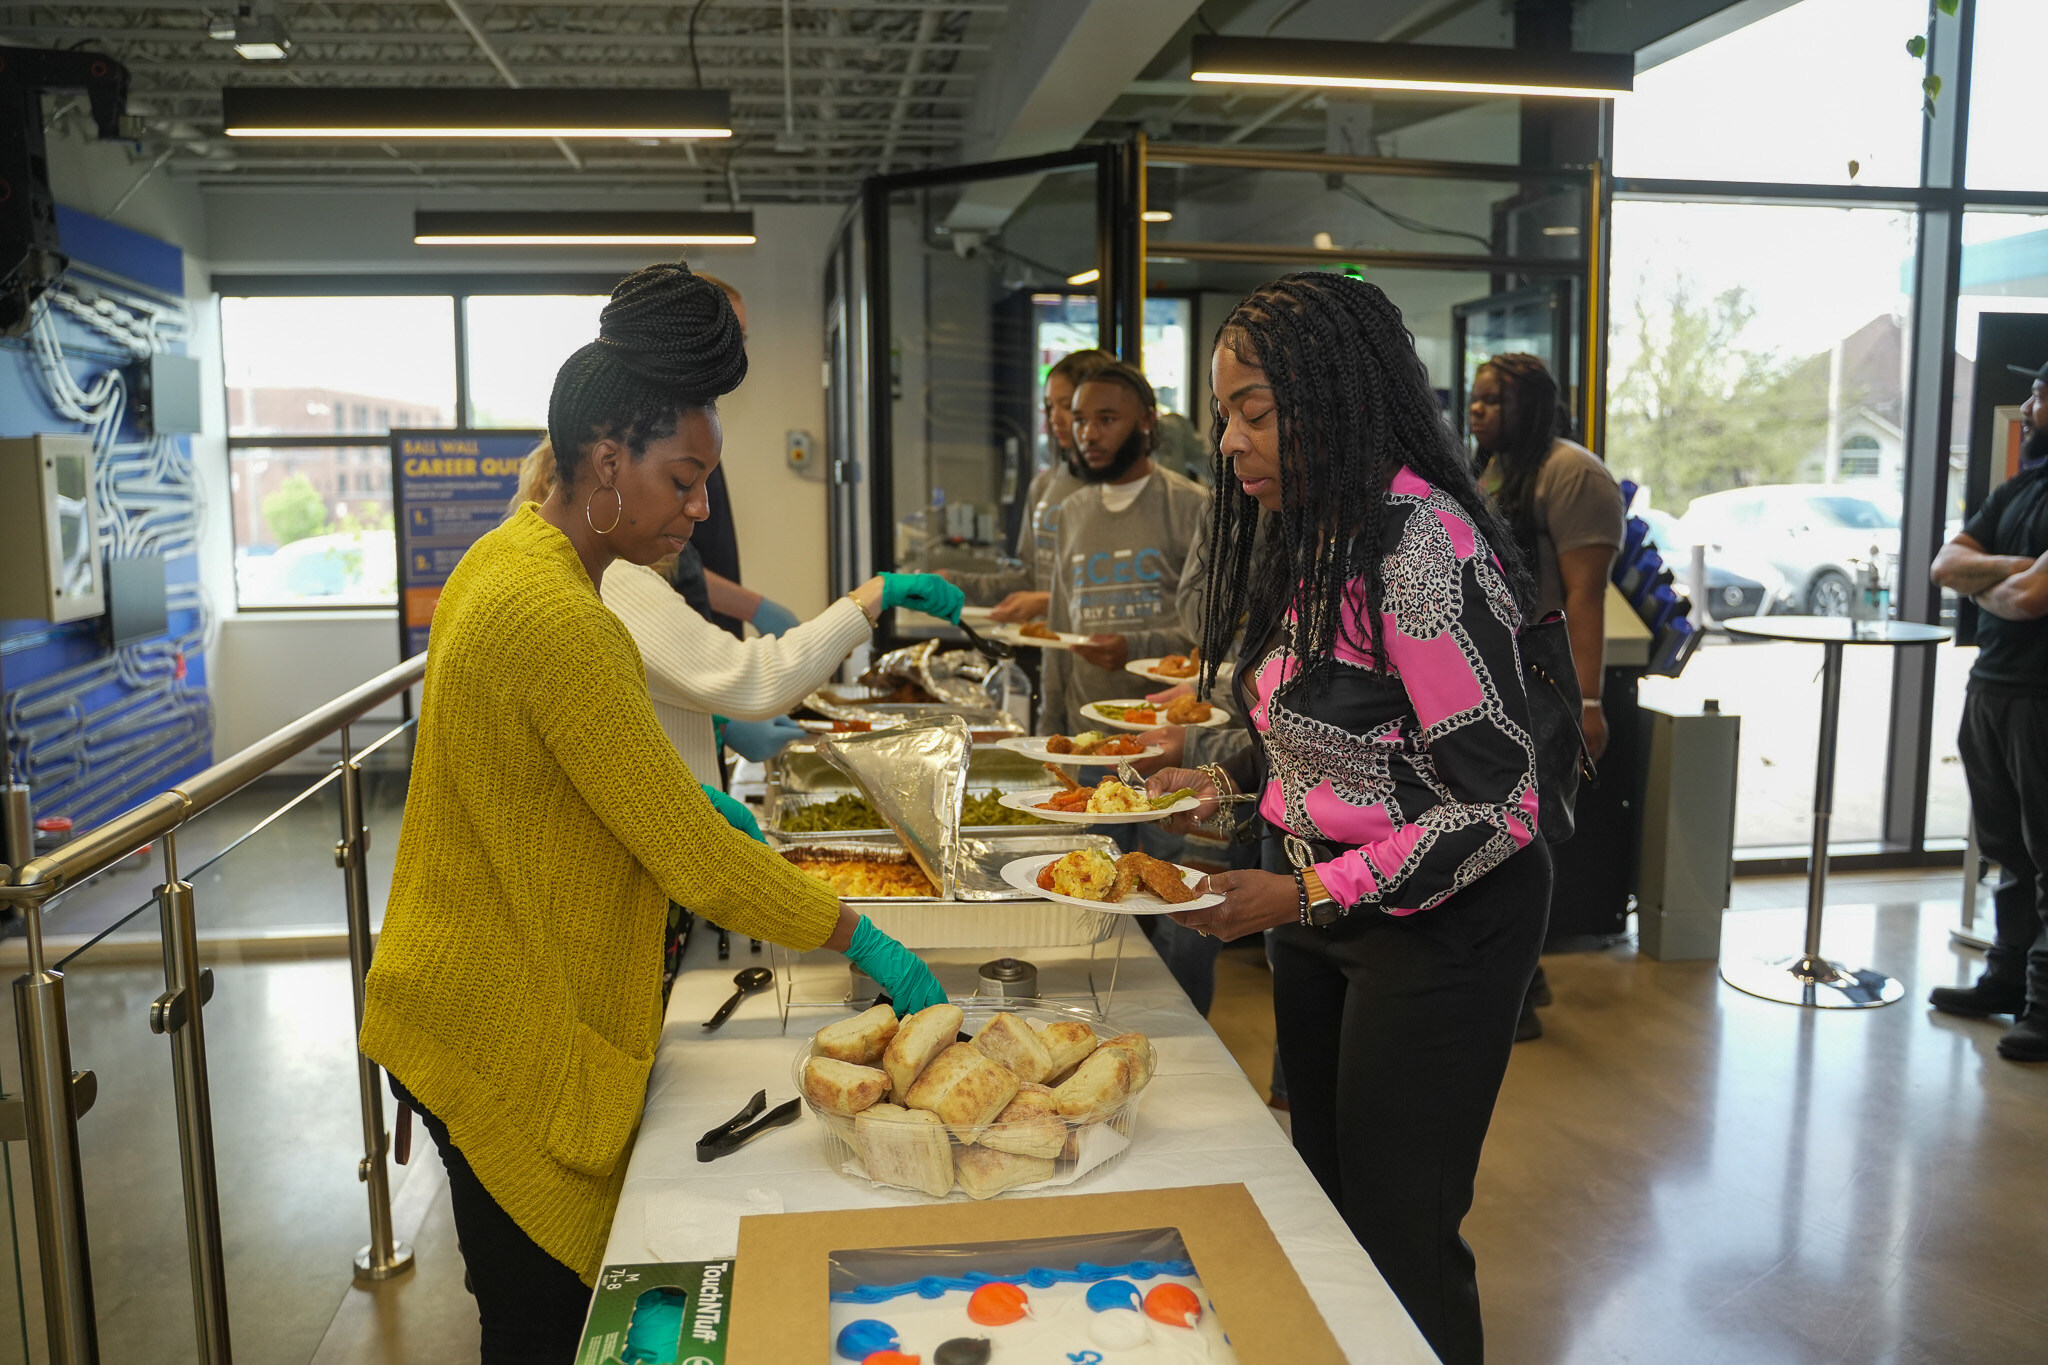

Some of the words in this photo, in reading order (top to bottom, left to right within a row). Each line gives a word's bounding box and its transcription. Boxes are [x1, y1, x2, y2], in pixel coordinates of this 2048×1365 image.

[402, 440, 437, 455] BALL
[441, 440, 479, 454] WALL
[404, 458, 477, 477] CAREER
[625, 1273, 640, 1282] M
